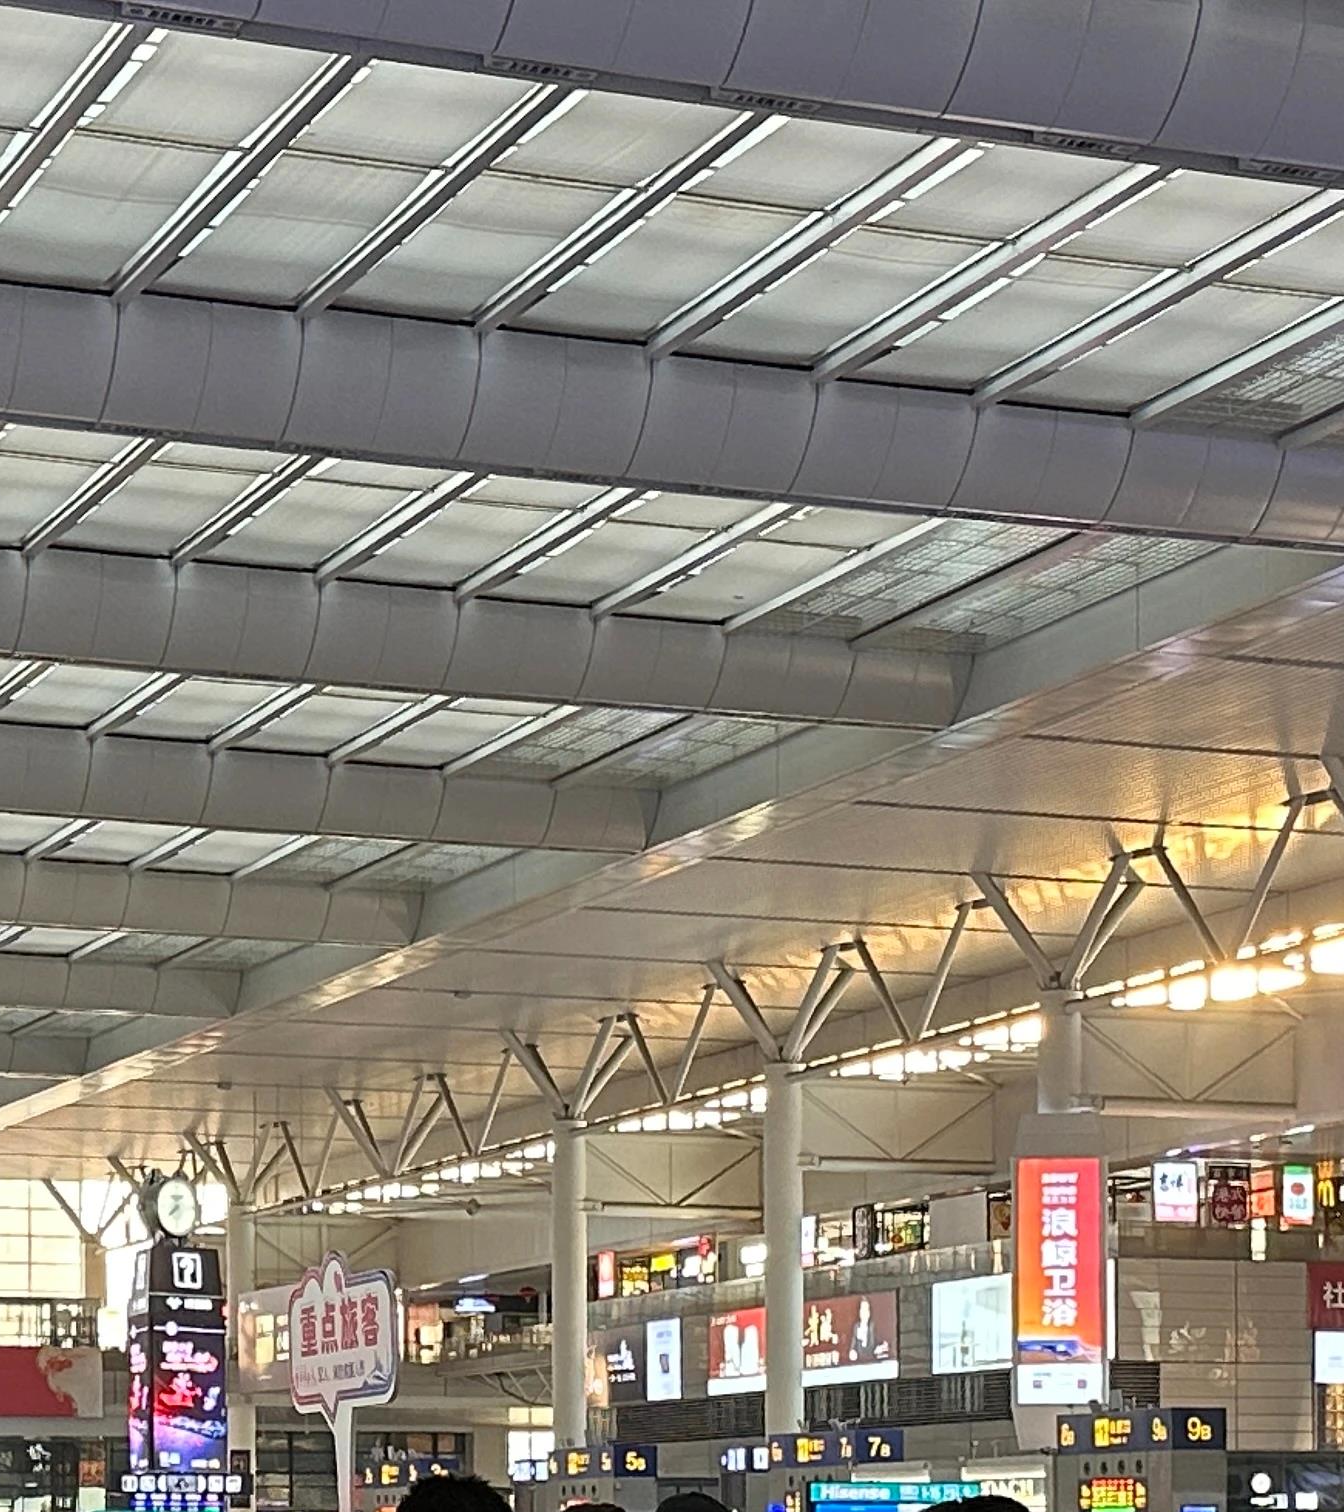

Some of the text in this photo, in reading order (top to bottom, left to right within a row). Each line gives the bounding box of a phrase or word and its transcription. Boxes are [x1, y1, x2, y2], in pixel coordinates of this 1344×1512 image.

[1041, 1208, 1078, 1327] 浪鲸卫浴
[300, 1293, 379, 1357] 重点旅客
[1187, 1416, 1212, 1441] 9B
[868, 1436, 891, 1457] 7B
[820, 1485, 891, 1500] Hisense
